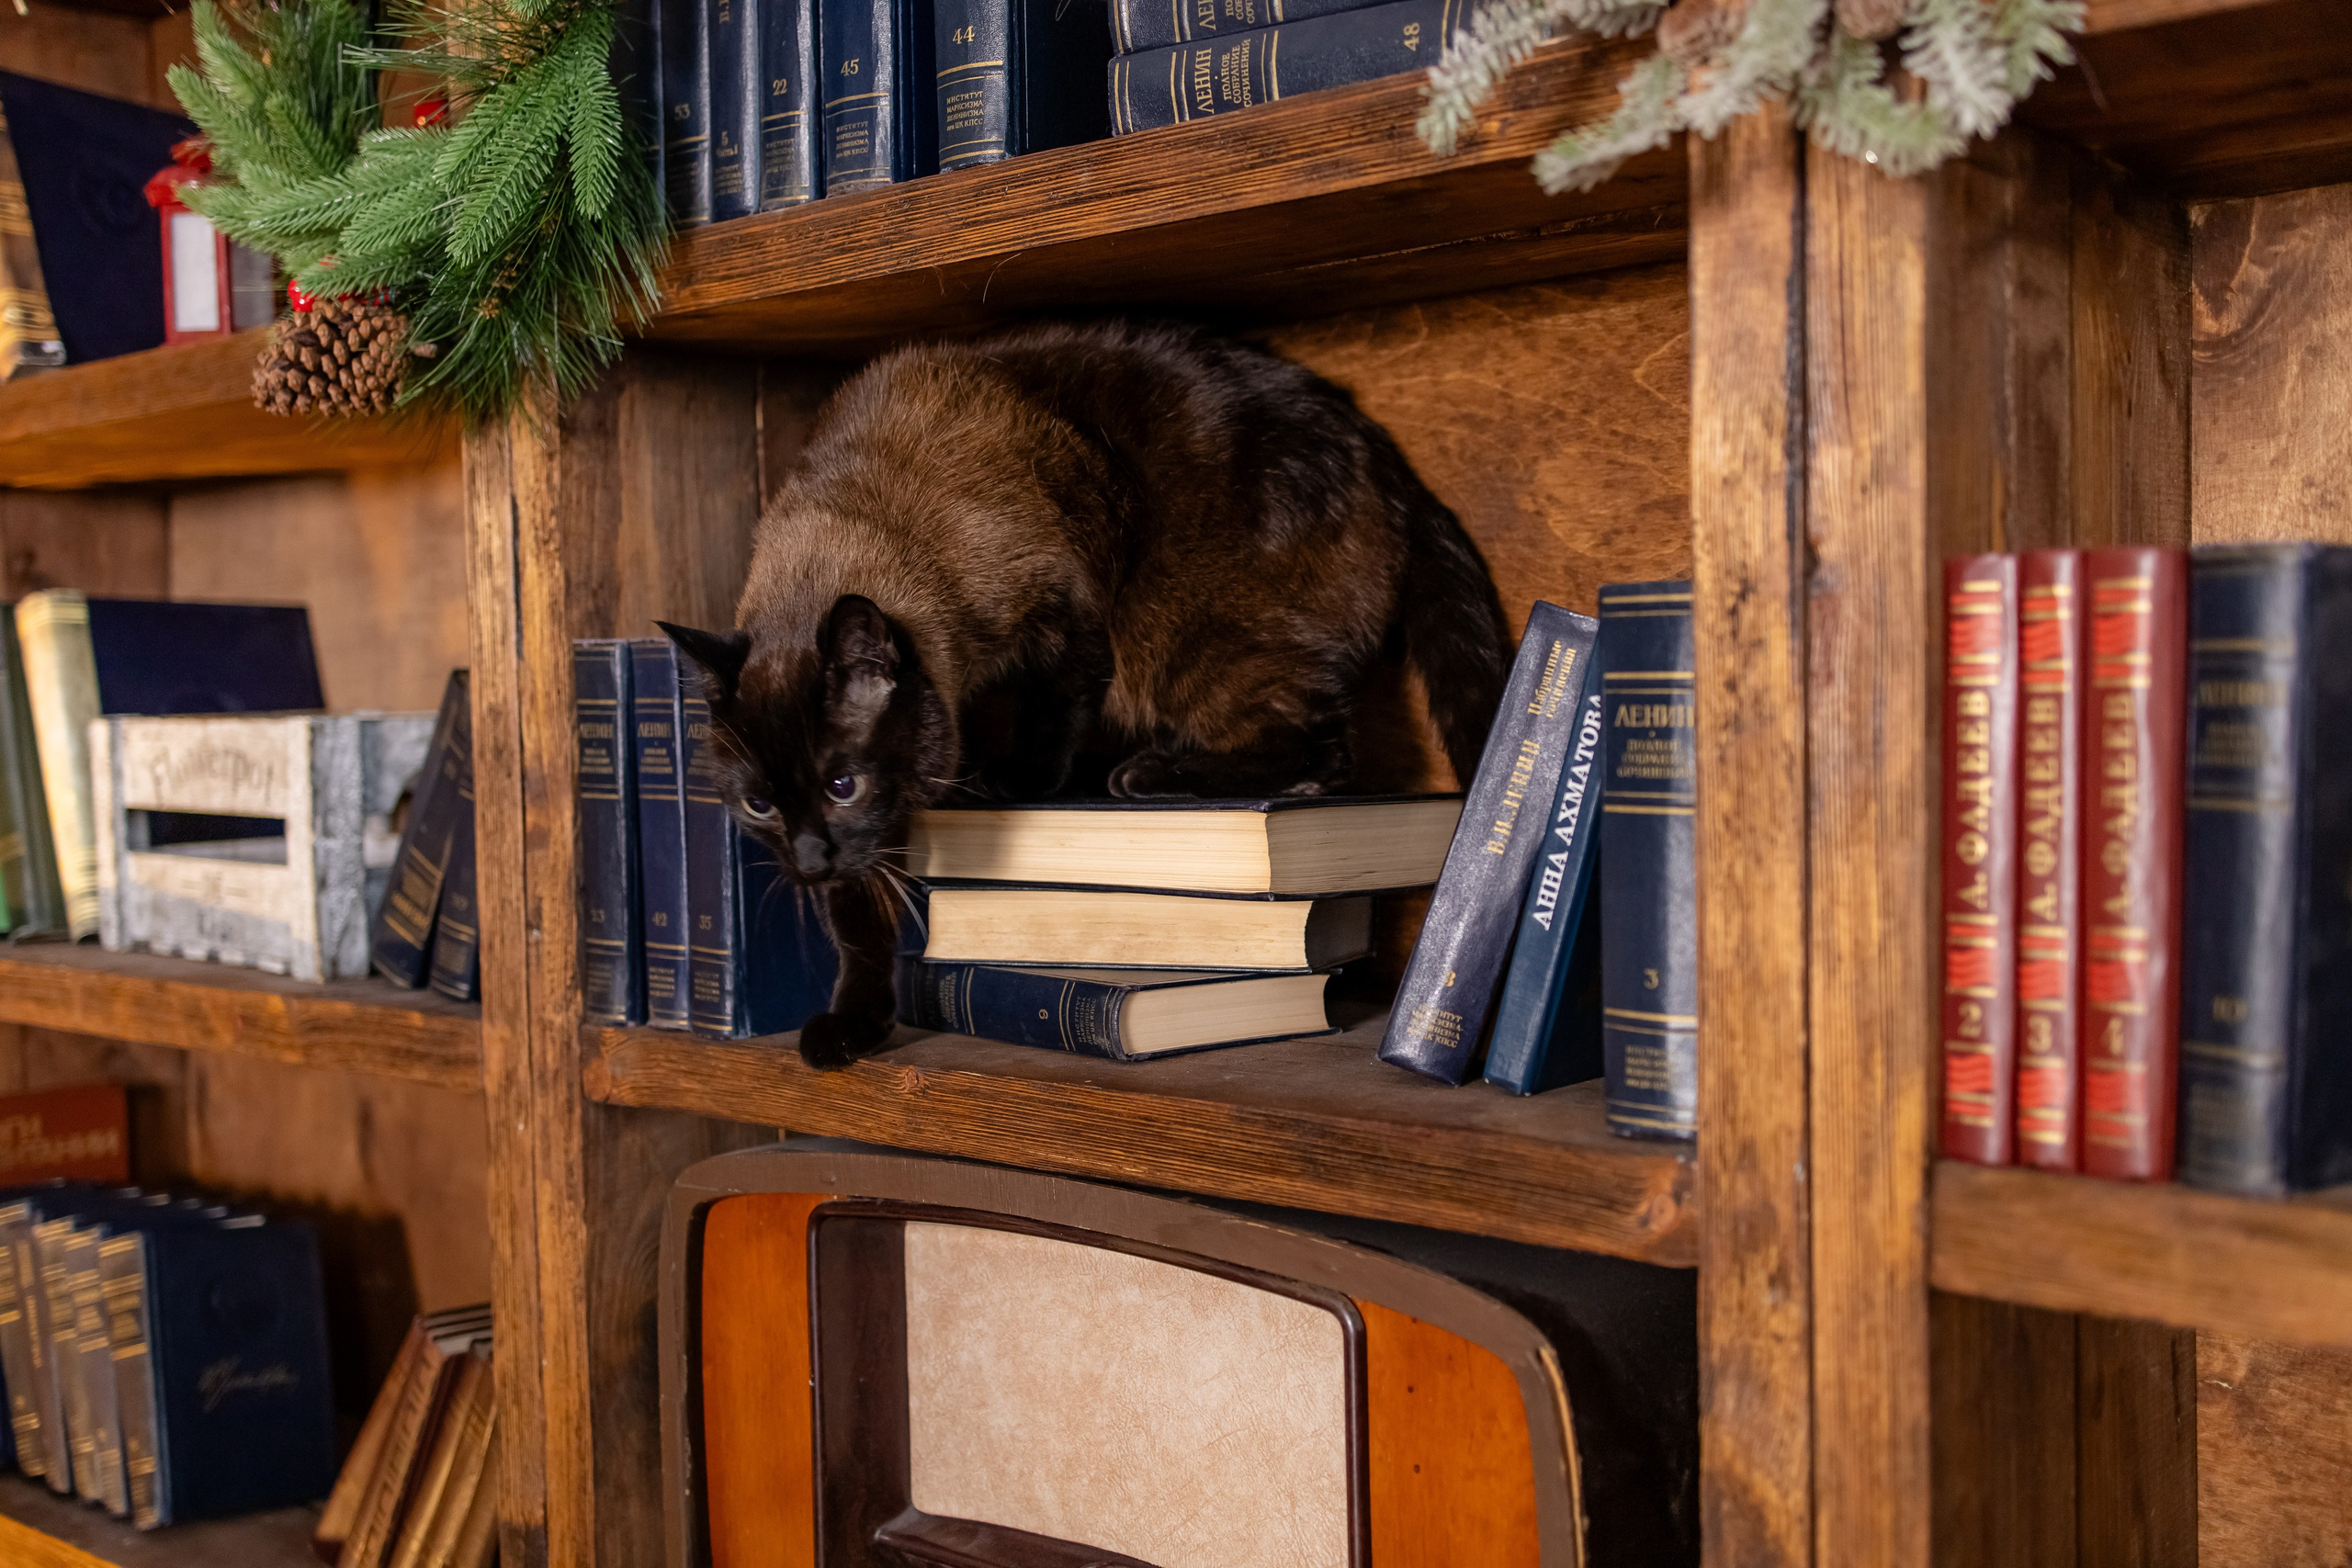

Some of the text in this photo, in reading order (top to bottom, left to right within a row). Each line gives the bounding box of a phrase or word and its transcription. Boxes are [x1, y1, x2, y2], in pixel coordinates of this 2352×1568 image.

[952, 25, 975, 45] 44
[1403, 22, 1420, 52] 48
[841, 58, 860, 76] 45
[1194, 47, 1215, 114] ЛЕНИН
[1221, 52, 1232, 101] ПОЛНОЕ
[1231, 44, 1242, 104] СОБРАНИЕ
[1241, 38, 1253, 107] СОЧИНЕНИЙ
[773, 79, 787, 96] 22
[946, 90, 984, 105] ИНСТИТУТ
[964, 118, 984, 127] КПСС
[1956, 691, 1992, 866] ФАДЕЕВ
[2025, 697, 2064, 877] ФАДЕЕВ
[1532, 851, 1568, 931] АННА
[652, 911, 667, 927] 42
[699, 914, 713, 931] 35
[1644, 967, 1659, 989] 3
[1958, 1000, 1982, 1039] 2
[2027, 1014, 2053, 1054] 3
